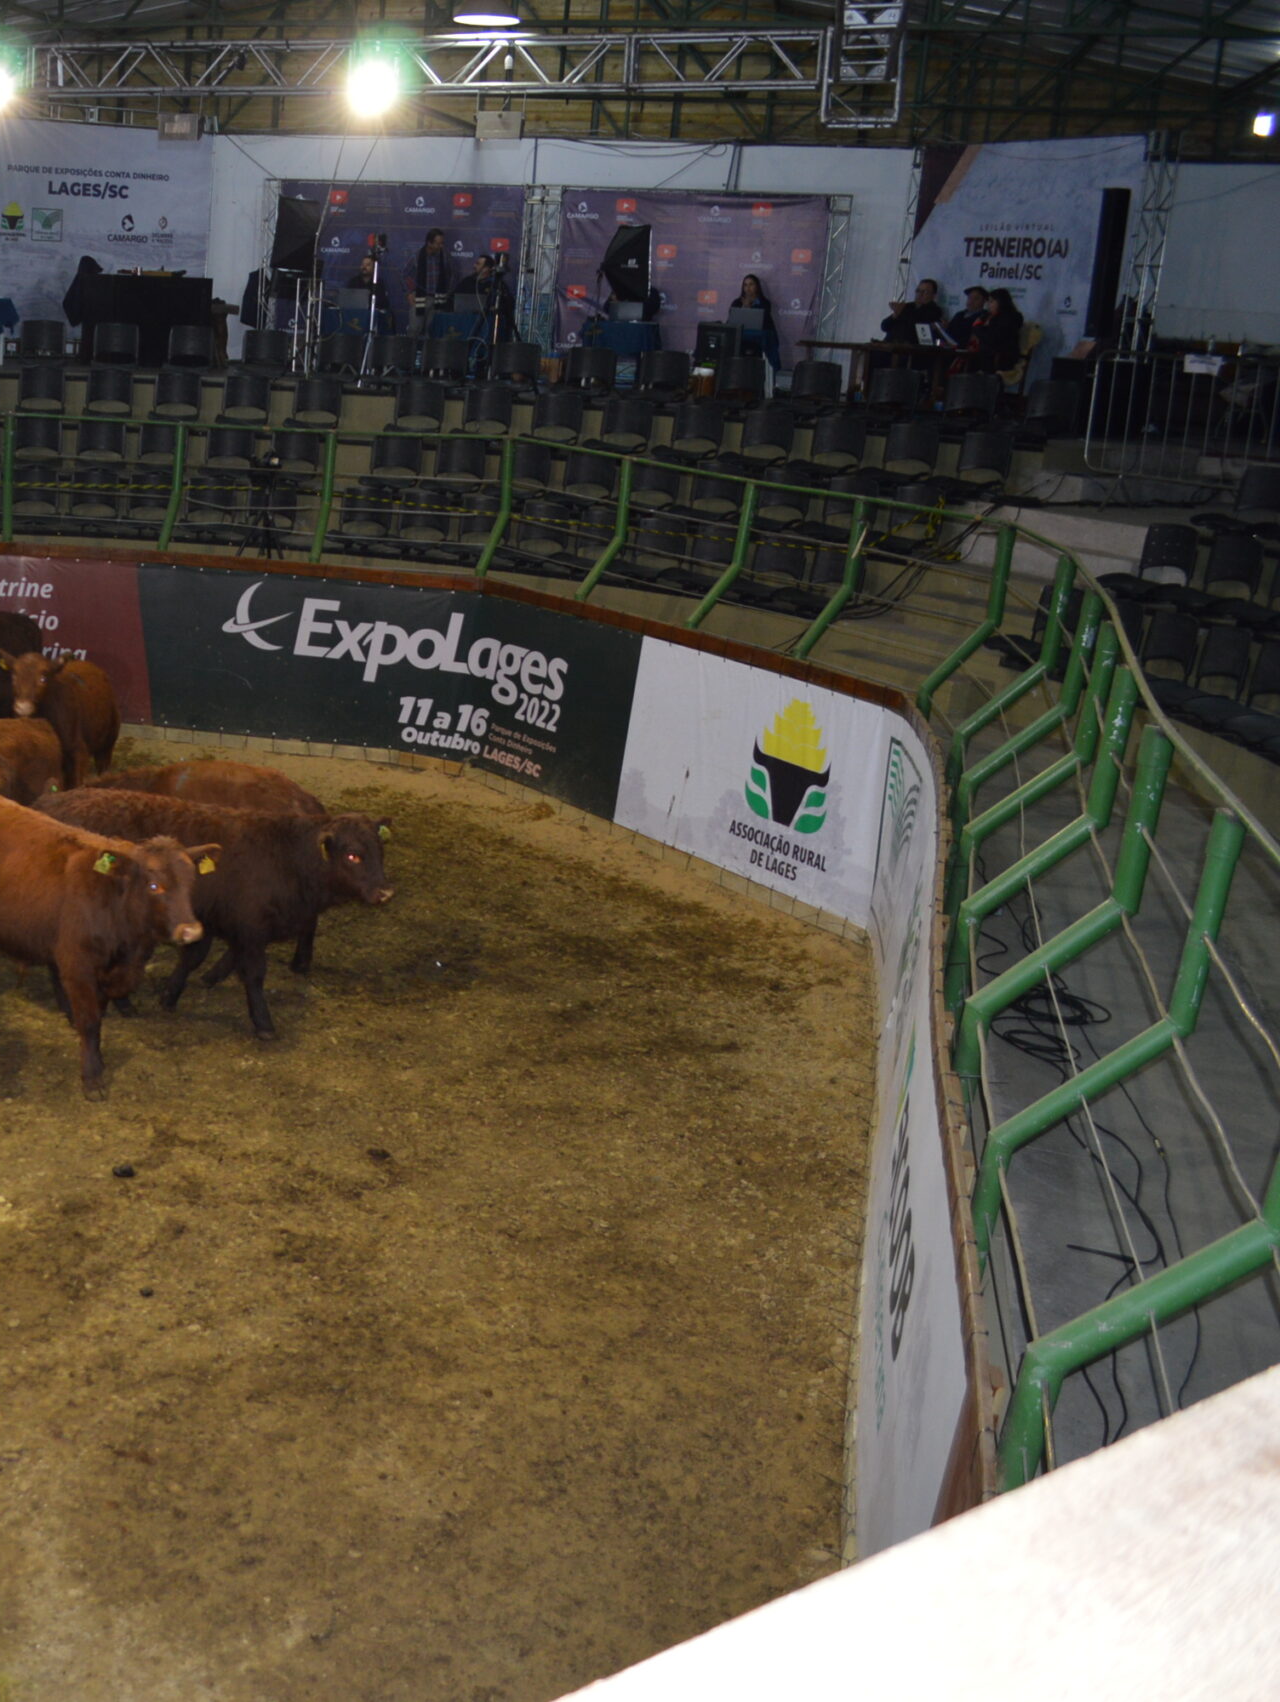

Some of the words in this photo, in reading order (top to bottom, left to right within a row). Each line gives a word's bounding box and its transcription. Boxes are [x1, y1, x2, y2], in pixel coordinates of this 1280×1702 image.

[7, 164, 40, 174] PARQUE
[42, 166, 52, 175] DE
[54, 165, 103, 178] EXPOSIÇÕES
[105, 170, 131, 179] CONTA
[133, 172, 170, 182] DINHEIRO
[48, 181, 129, 199] LAGES/SC
[567, 212, 599, 220] CAMARGO
[1014, 223, 1055, 232] VIRTUAL
[107, 234, 148, 243] CAMARGO
[293, 597, 569, 706] ExpoLages
[397, 695, 434, 727] 11
[433, 708, 451, 729] a
[456, 703, 490, 737] 16
[514, 691, 562, 733] 2022
[401, 726, 481, 755] Outubro
[482, 744, 542, 778] LAGES/SC
[729, 819, 790, 857] ASSOCIAÇÃO
[792, 844, 827, 873] RURAL
[750, 849, 765, 868] DE
[765, 855, 798, 881] LAGES
